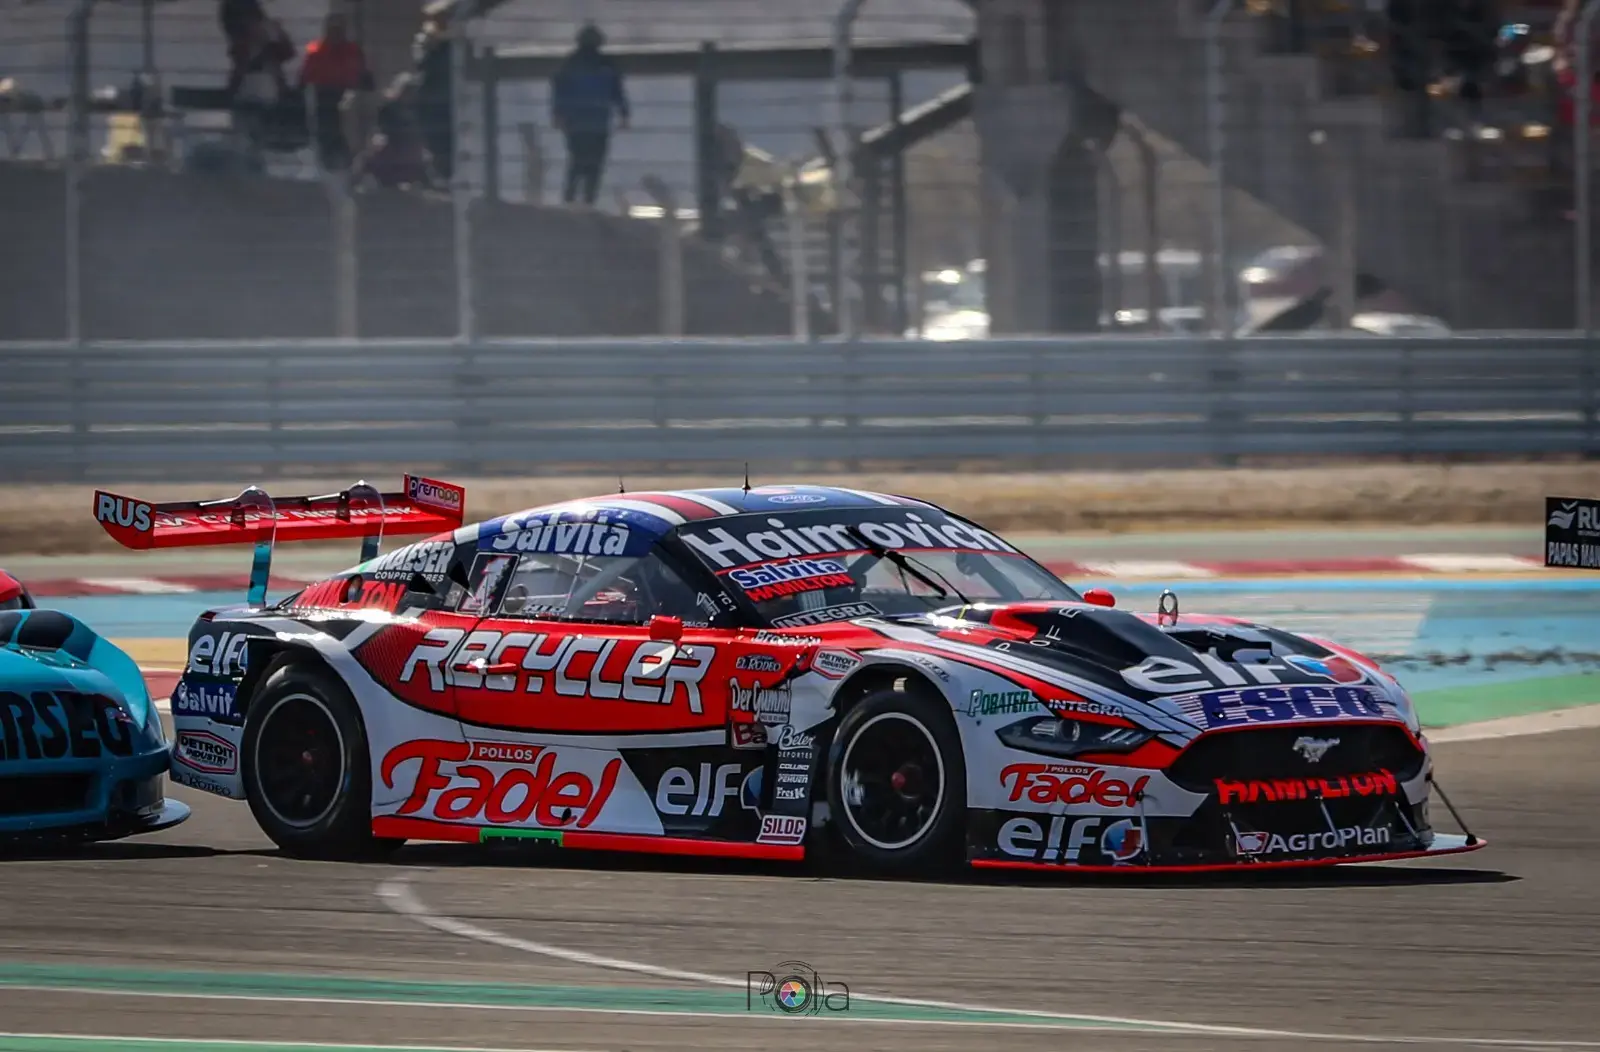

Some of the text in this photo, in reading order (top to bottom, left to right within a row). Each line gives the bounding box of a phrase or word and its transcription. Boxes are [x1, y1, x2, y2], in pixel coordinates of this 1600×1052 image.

[98, 494, 151, 531] RUS
[492, 510, 632, 555] Salvita
[688, 512, 1019, 568] Haimovich
[1548, 542, 1579, 565] PAPAS
[375, 571, 444, 583] COMPREORES
[731, 558, 847, 588] Salvita
[745, 573, 855, 602] HAMILTON
[776, 603, 875, 628] INTEGRA
[189, 631, 247, 675] elf
[747, 658, 781, 672] RODEO
[819, 652, 858, 666] DETROIT
[400, 627, 715, 713] RECYCLER
[1119, 647, 1287, 693] elf
[178, 683, 238, 717] Salvit
[1048, 698, 1125, 717] INTEGRA
[0, 690, 133, 760] RSEG
[180, 734, 234, 758] DETROIT
[186, 748, 228, 765] INDUSTRY
[479, 747, 533, 760] POLLOS
[778, 751, 813, 759] DEPORTES
[380, 738, 622, 829] Fadel
[1051, 766, 1089, 774] POLLOS
[655, 762, 742, 817] elf
[1000, 763, 1151, 808] Fadel
[996, 816, 1101, 860] elf
